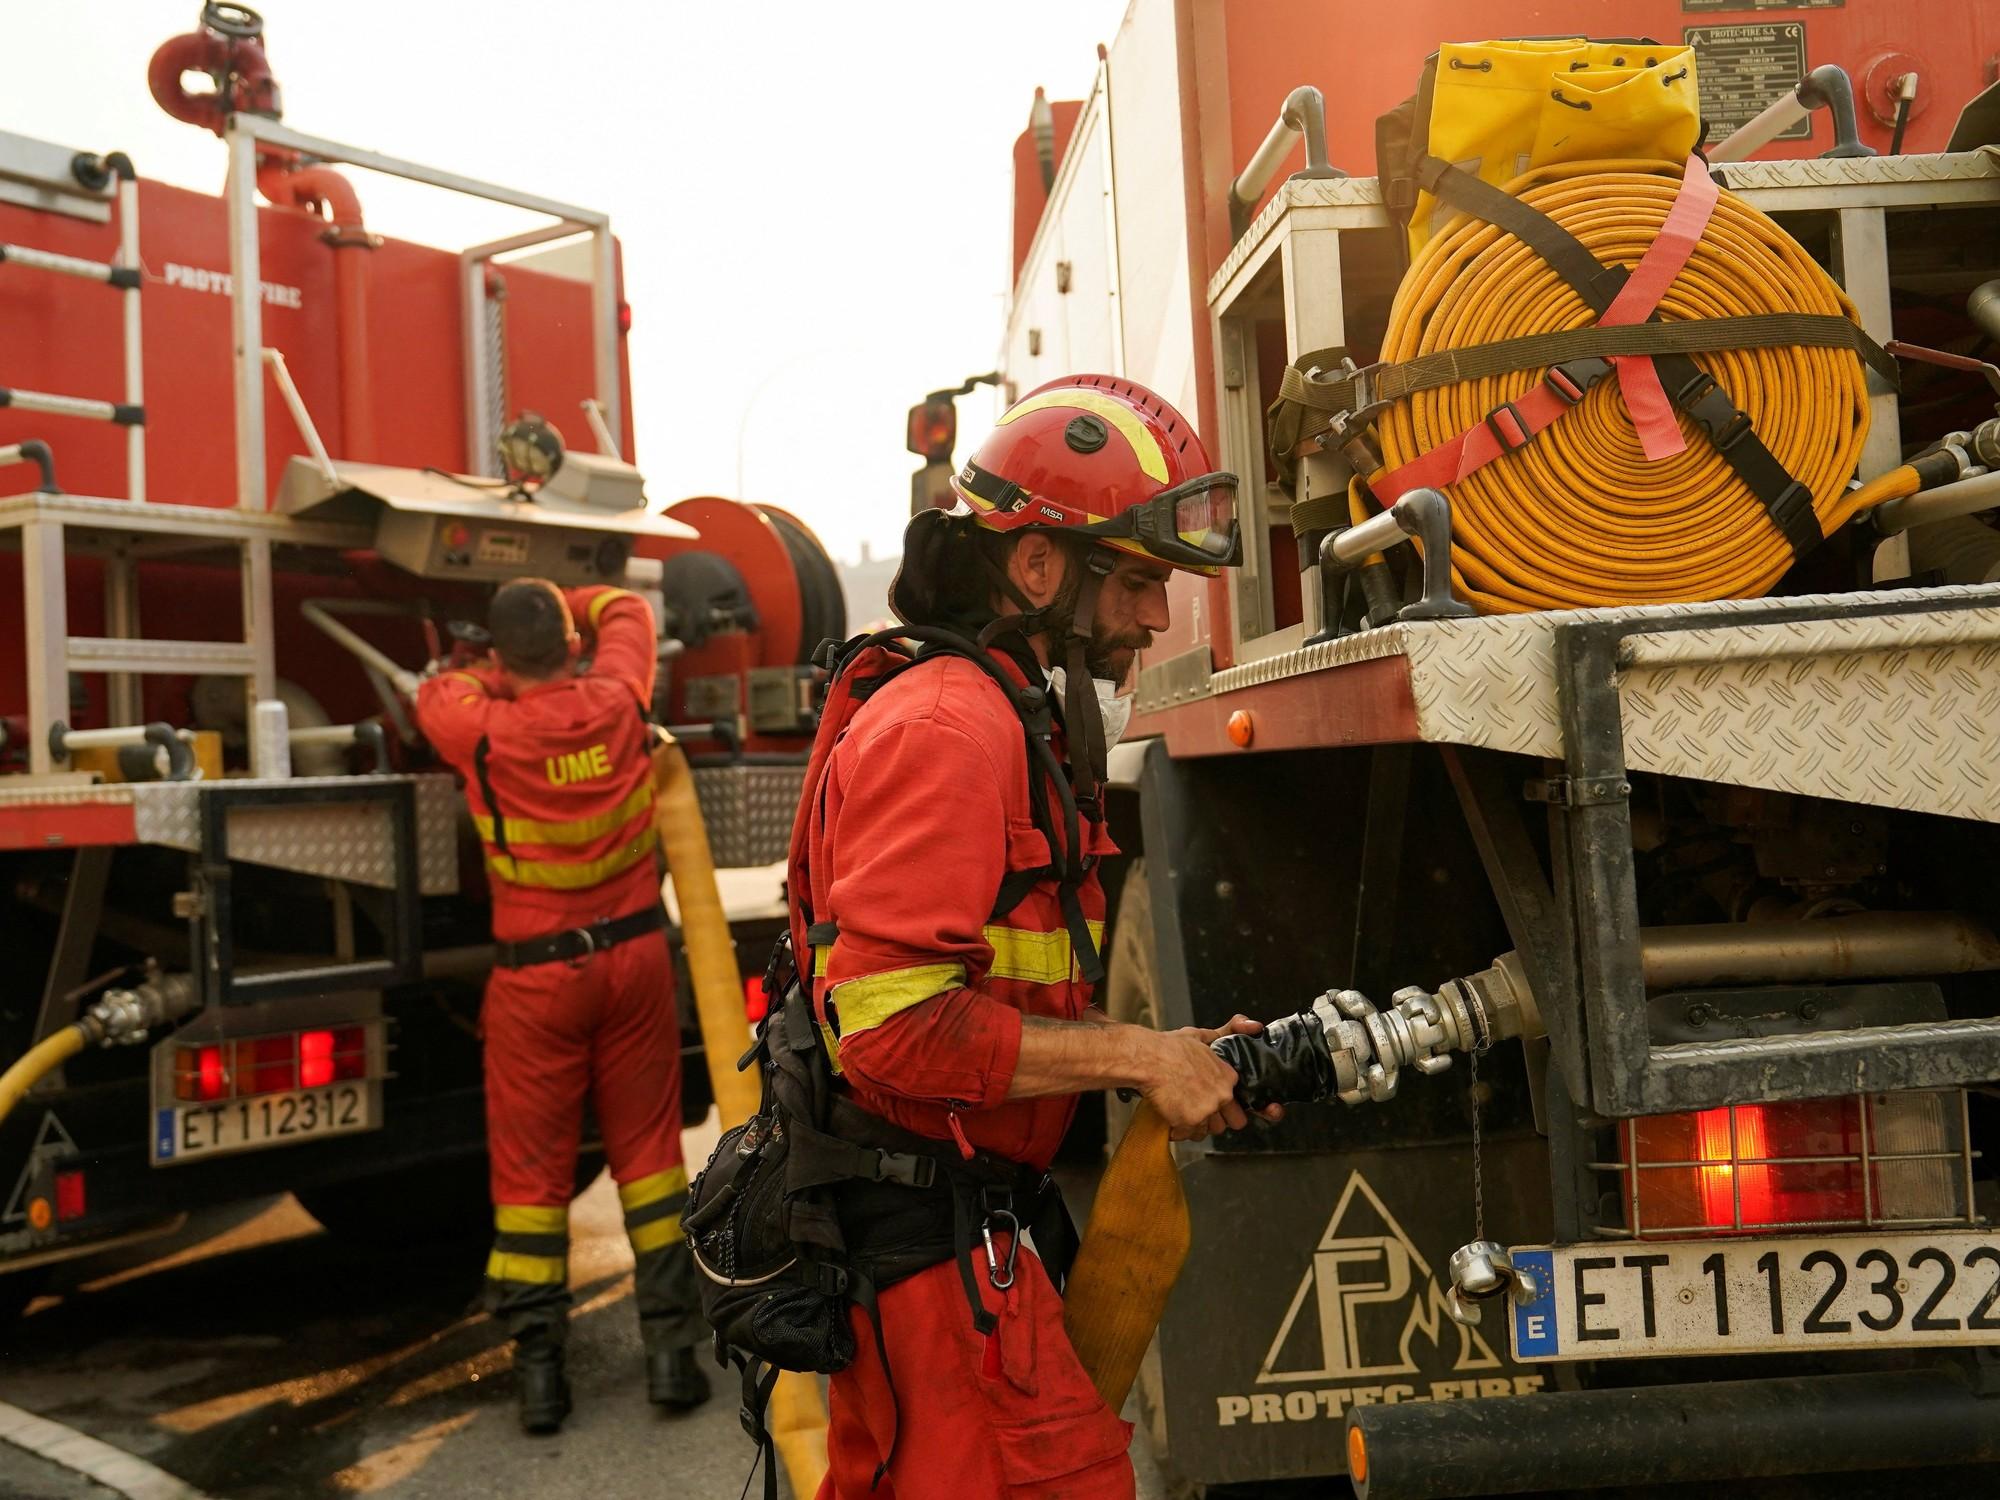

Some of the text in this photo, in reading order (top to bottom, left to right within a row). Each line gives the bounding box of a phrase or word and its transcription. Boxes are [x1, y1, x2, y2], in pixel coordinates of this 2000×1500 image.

[1710, 28, 1761, 38] PROTEC-FIRE
[1785, 27, 1798, 38] CE
[1040, 506, 1063, 521] MSA
[546, 744, 613, 787] UME
[183, 1087, 359, 1150] ET 112312
[1574, 1246, 2000, 1342] ET 112322
[1527, 1316, 1546, 1339] E
